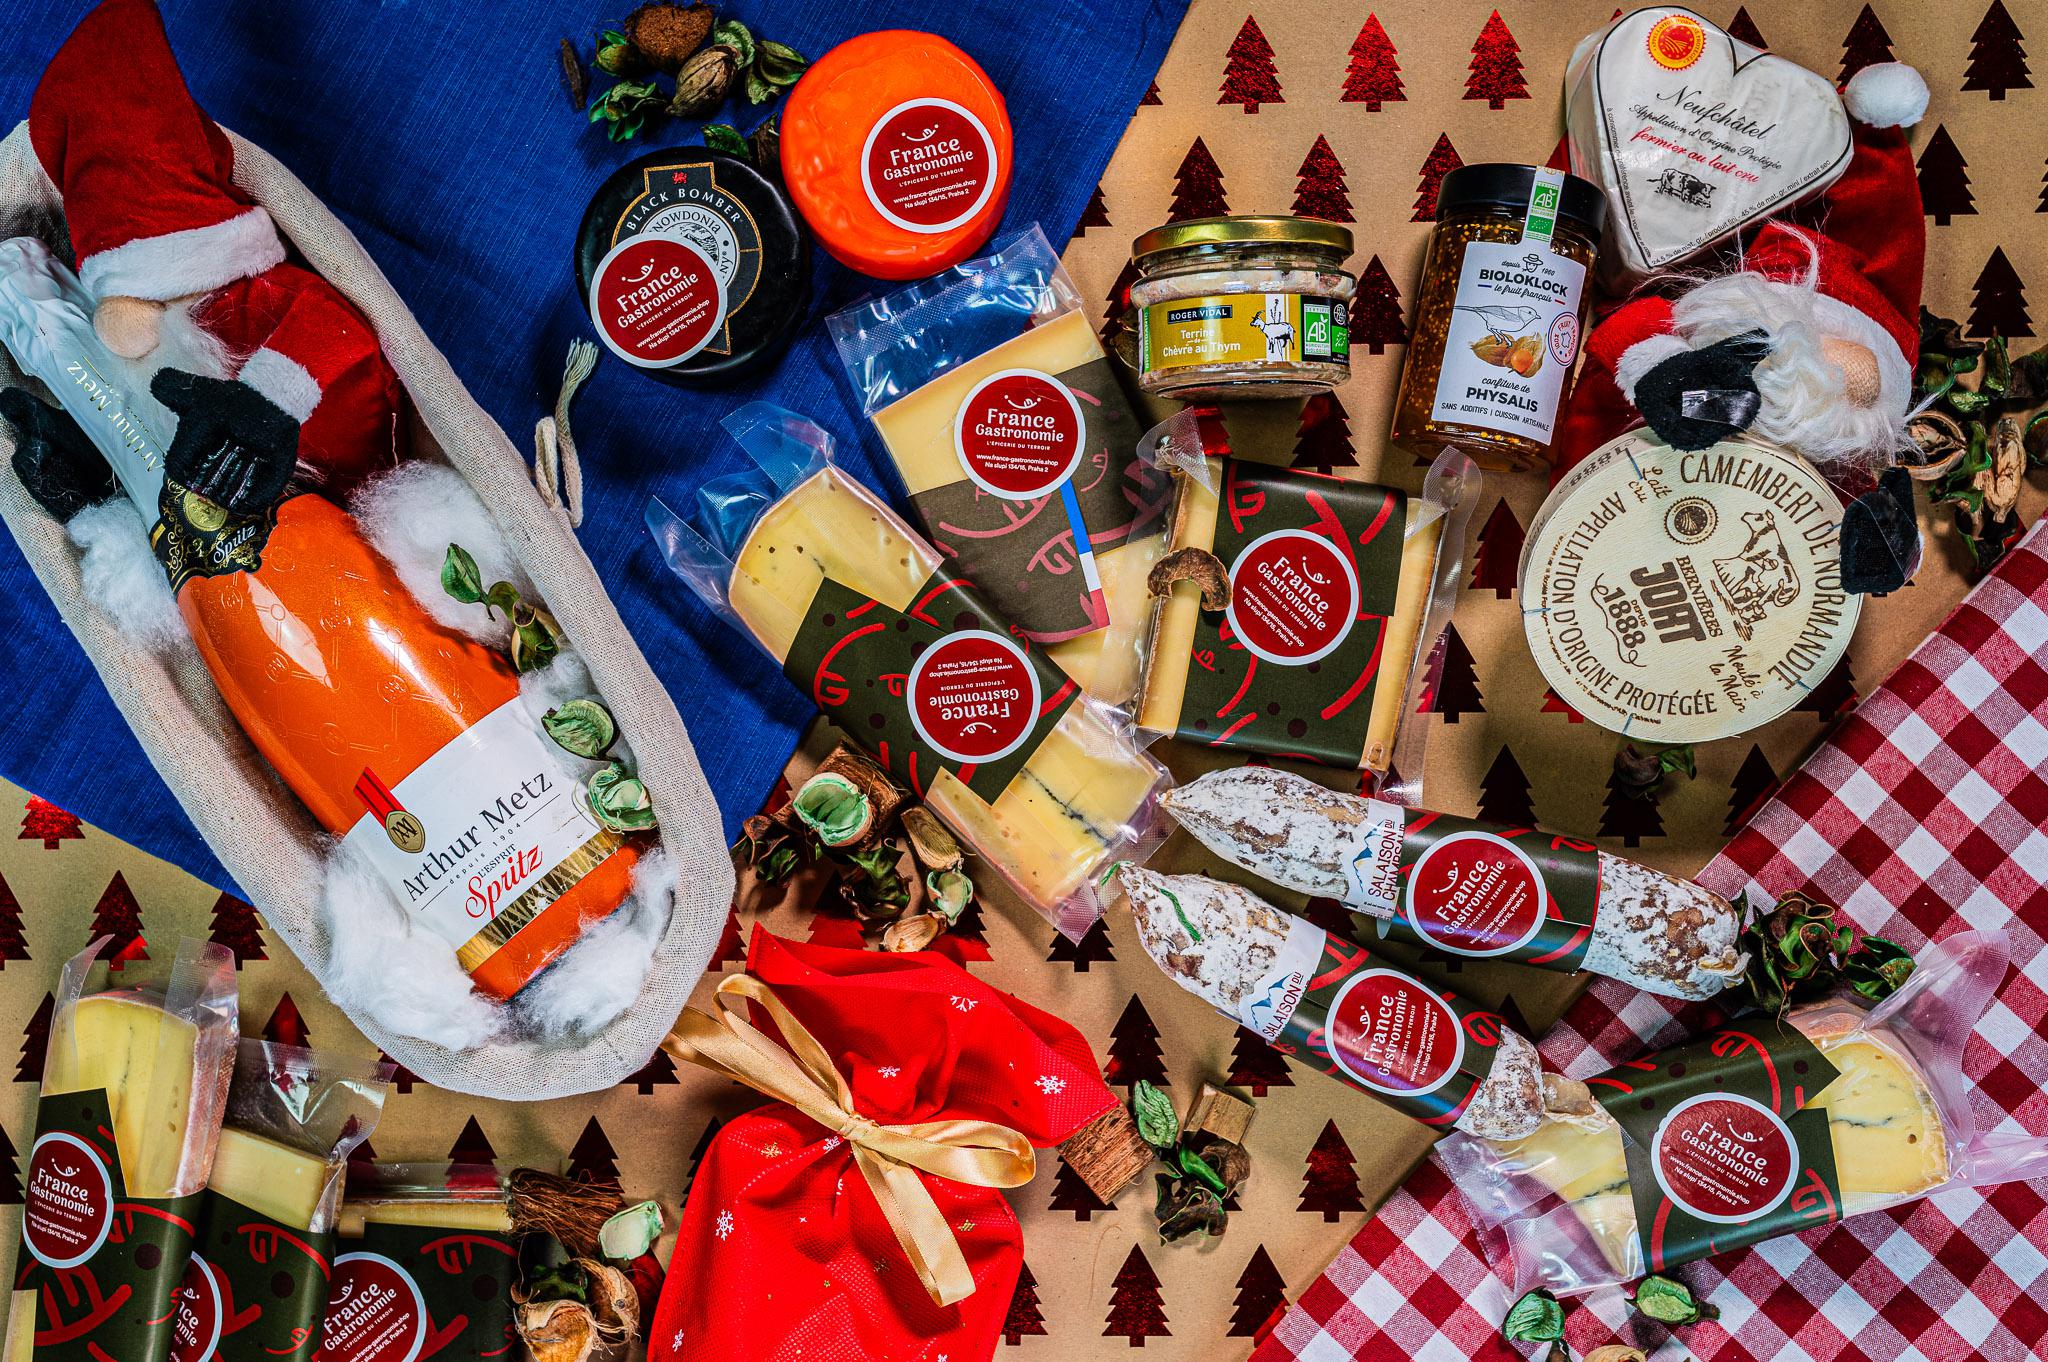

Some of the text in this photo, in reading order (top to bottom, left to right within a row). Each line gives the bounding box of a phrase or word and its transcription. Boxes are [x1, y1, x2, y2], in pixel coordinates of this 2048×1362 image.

[1656, 85, 1776, 140] Neufchâtel
[889, 138, 960, 166] France
[1629, 103, 1782, 171] Appellation d'Origine Protégée
[1630, 126, 1760, 183] fermier au lait cru
[883, 149, 974, 180] Gastronomie
[939, 167, 963, 177] TERROIR
[626, 188, 743, 231] BLACK BOMBER
[893, 179, 977, 204] www.france-gastronomie.shop
[913, 197, 928, 207] slupi
[947, 190, 965, 198] Praha
[1534, 192, 1553, 208] AB
[1706, 221, 1729, 238] produit
[1764, 192, 1778, 203] mat.
[1785, 179, 1799, 190] mini
[1801, 165, 1821, 181] extrait
[1819, 159, 1831, 169] sec
[1479, 267, 1569, 298] BIOLOKLOCK
[1501, 260, 1521, 269] depuis
[616, 266, 682, 312] France
[617, 273, 698, 328] Gastronomie
[663, 305, 671, 313] DU
[671, 292, 693, 307] TERROIR
[1494, 284, 1553, 304] le fruit français
[636, 299, 710, 348] www.france-gastronomie.shop
[1170, 308, 1228, 320] ROGER VIDAL
[1180, 328, 1215, 339] Terrine
[1307, 321, 1327, 342] AB
[1163, 342, 1241, 357] Chèvre au Thym
[66, 360, 112, 411] Metz
[1466, 387, 1539, 413] PHYSALIS
[1481, 377, 1531, 393] confiture de
[975, 423, 1064, 442] Gastronomie
[987, 408, 1055, 429] France
[1441, 402, 1550, 432] SANS ADDITIFS CUISSON ARTISANALE
[976, 454, 1058, 467] www.france-gastronomie.shop
[993, 462, 1007, 470] slupi
[1027, 464, 1044, 472] Praha
[1628, 478, 1647, 505] cru
[1680, 453, 1824, 527] CAMEMBERT
[213, 525, 257, 565] Spritz
[1551, 491, 1627, 605] APPELLATION
[1802, 519, 1841, 555] DE
[1257, 561, 1326, 631] Gastronomie
[1273, 556, 1329, 614] France
[1629, 560, 1707, 645] JORT
[1676, 554, 1725, 639] BERNIÈRES
[1242, 585, 1304, 647] www.france-gastronomie.shop
[1281, 603, 1289, 612] DU
[1289, 610, 1308, 629] TERROIR
[1603, 586, 1647, 650] 1888
[1630, 599, 1649, 628] DEPUIS
[1767, 559, 1847, 691] NORMANDIE
[928, 664, 1013, 678] www.france-gastronomie.shop
[1553, 608, 1620, 695] D'ORIGINE
[1722, 645, 1762, 689] Moulé
[929, 688, 1019, 708] Gastronomie
[1613, 680, 1718, 716] PROTÉGÉE
[1709, 663, 1748, 714] la Main
[941, 701, 1010, 720] France
[402, 772, 553, 902] Arthur Metz
[449, 822, 521, 885] depuis 1904
[477, 843, 517, 879] L'ESPRIT
[1368, 830, 1397, 898] SALAISON
[1384, 819, 1393, 829] DU
[465, 844, 543, 919] Spritz
[1435, 860, 1489, 921] France
[1444, 860, 1507, 937] Gastronomie
[1483, 900, 1492, 908] DU
[1262, 971, 1302, 1037] SALAISON DU
[1364, 995, 1394, 1064] France
[1377, 989, 1408, 1077] Gastronomie
[1680, 1129, 1769, 1186] Gastronomie
[1697, 1121, 1767, 1170] France
[27, 1181, 94, 1217] Gastronomie
[36, 1169, 89, 1201] France
[321, 1283, 381, 1334] France
[324, 1288, 397, 1350] Gastronomie
